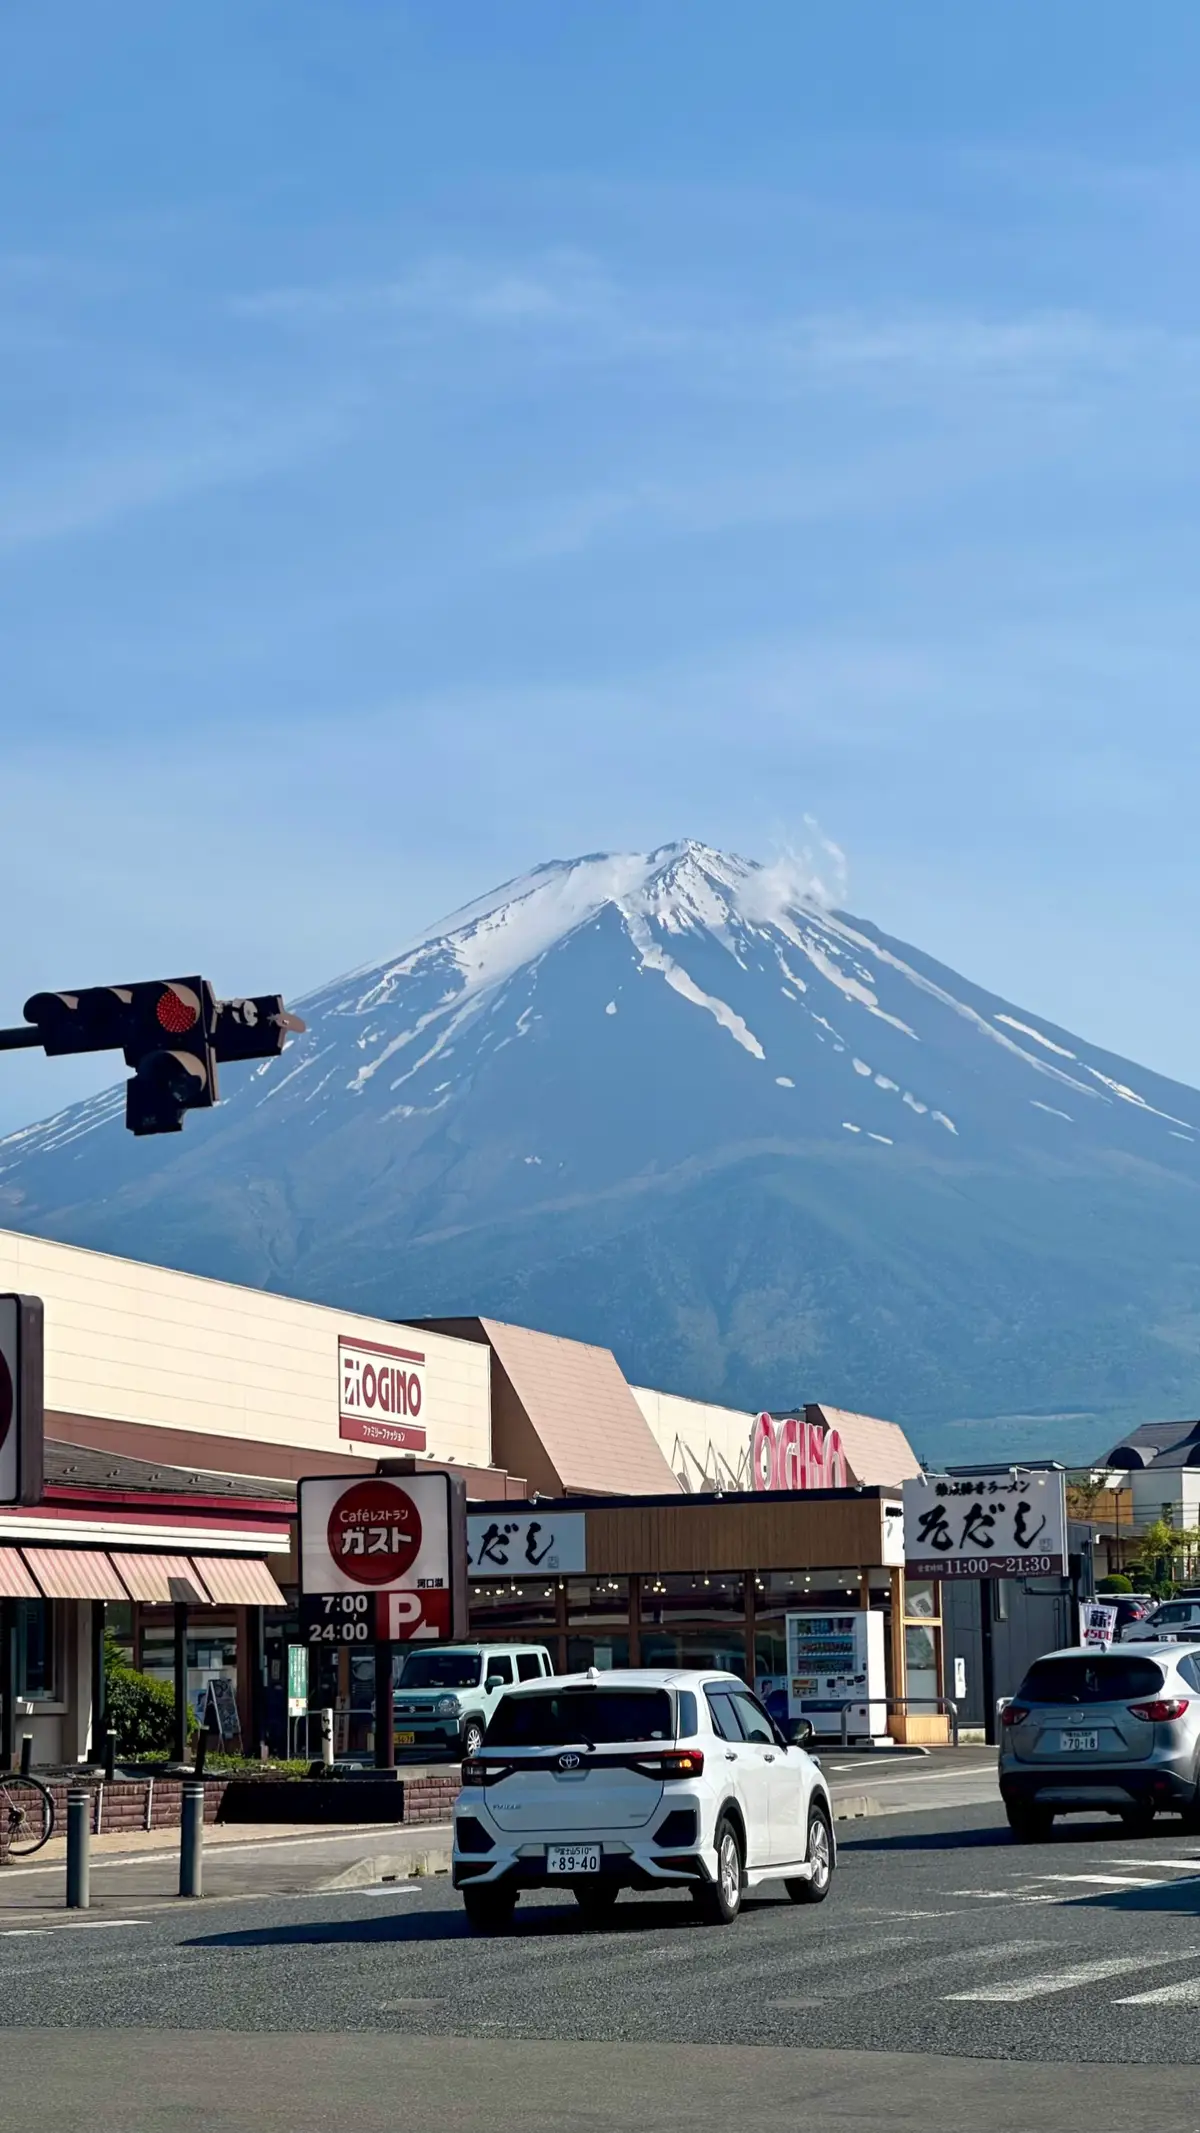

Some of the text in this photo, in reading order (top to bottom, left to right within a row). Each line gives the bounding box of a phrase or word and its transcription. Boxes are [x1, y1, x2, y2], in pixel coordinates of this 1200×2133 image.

[362, 1363, 421, 1417] OGINO
[341, 1527, 412, 1555] ガスト
[466, 1522, 554, 1566] だし
[417, 1577, 444, 1589] 河口湖
[322, 1594, 368, 1614] 7:00
[388, 1593, 422, 1640] P
[309, 1623, 368, 1642] 24:00
[559, 1855, 597, 1871] 89-40
